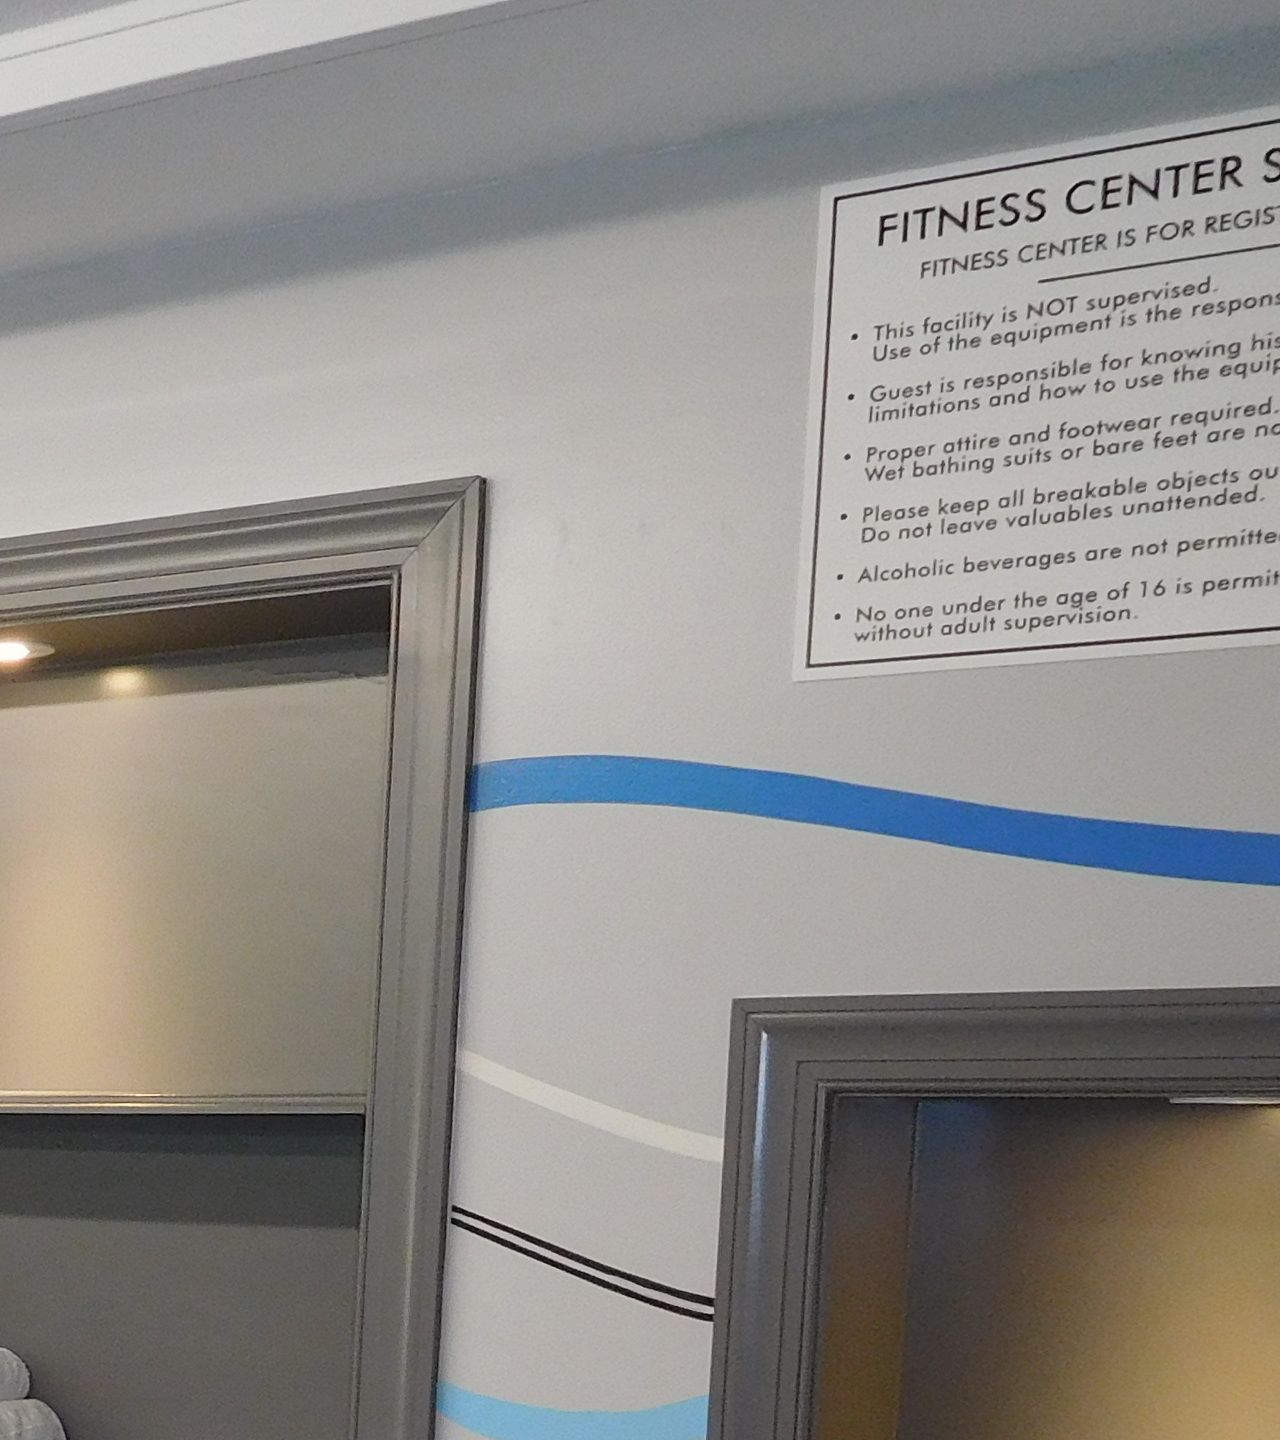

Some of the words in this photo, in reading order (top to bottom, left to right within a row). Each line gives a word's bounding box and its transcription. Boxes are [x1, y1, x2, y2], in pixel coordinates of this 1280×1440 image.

[878, 189, 1046, 246] FITNESS
[1066, 156, 1243, 214] CENTER
[920, 249, 1008, 279] FITNESS
[1018, 234, 1107, 263] CENTER
[1117, 229, 1136, 248] IS
[1146, 220, 1194, 244] FOR
[873, 344, 911, 362] Use
[920, 336, 942, 356] of
[948, 333, 982, 350] the
[990, 316, 1112, 347] equipment
[1120, 311, 1136, 328] is
[1145, 305, 1181, 323] the
[1191, 291, 1280, 317] respons
[874, 322, 914, 341] This
[923, 311, 994, 334] facility
[1002, 307, 1017, 323] is
[1026, 296, 1078, 318] NOT
[868, 397, 980, 423] limitations
[989, 386, 1030, 407] and
[1039, 381, 1087, 402] how
[1094, 376, 1116, 394] to
[1125, 373, 1164, 390] use
[1172, 365, 1210, 383] the
[870, 381, 932, 403] Guest
[940, 377, 954, 393] is
[963, 358, 1091, 390] responsible
[1101, 350, 1133, 371] for
[1141, 340, 1241, 367] knowing
[865, 465, 905, 482] Wet
[912, 454, 995, 477] bathing
[1003, 448, 1051, 467] suits
[1060, 444, 1085, 459] or
[1093, 436, 1144, 456] bare
[1152, 431, 1199, 450] feet
[1207, 425, 1246, 443] are
[866, 444, 935, 462] Proper
[943, 435, 1000, 455] attire
[1008, 425, 1050, 446] and
[1058, 414, 1162, 441] footwear
[862, 503, 929, 522] Please
[938, 498, 990, 519] keep
[998, 489, 1024, 507] all
[1033, 477, 1147, 504] breakable
[1156, 468, 1239, 495] objects
[1248, 465, 1280, 481] ou
[861, 527, 890, 543] Do
[898, 522, 933, 540] not
[940, 516, 997, 535] leave
[1006, 504, 1113, 528] valuables
[857, 560, 955, 583] Alcoholic
[963, 548, 1076, 573] beverages
[1085, 544, 1122, 560] are
[1131, 539, 1169, 556] not
[1176, 529, 1280, 556] permitte
[856, 607, 886, 623] No
[894, 603, 934, 620] one
[942, 596, 1006, 616] under
[1014, 591, 1047, 608] the
[1056, 590, 1097, 608] age
[1107, 581, 1131, 600] of
[1140, 579, 1166, 597] 16
[1176, 577, 1192, 594] is
[854, 623, 934, 642] without
[941, 617, 996, 636] adult
